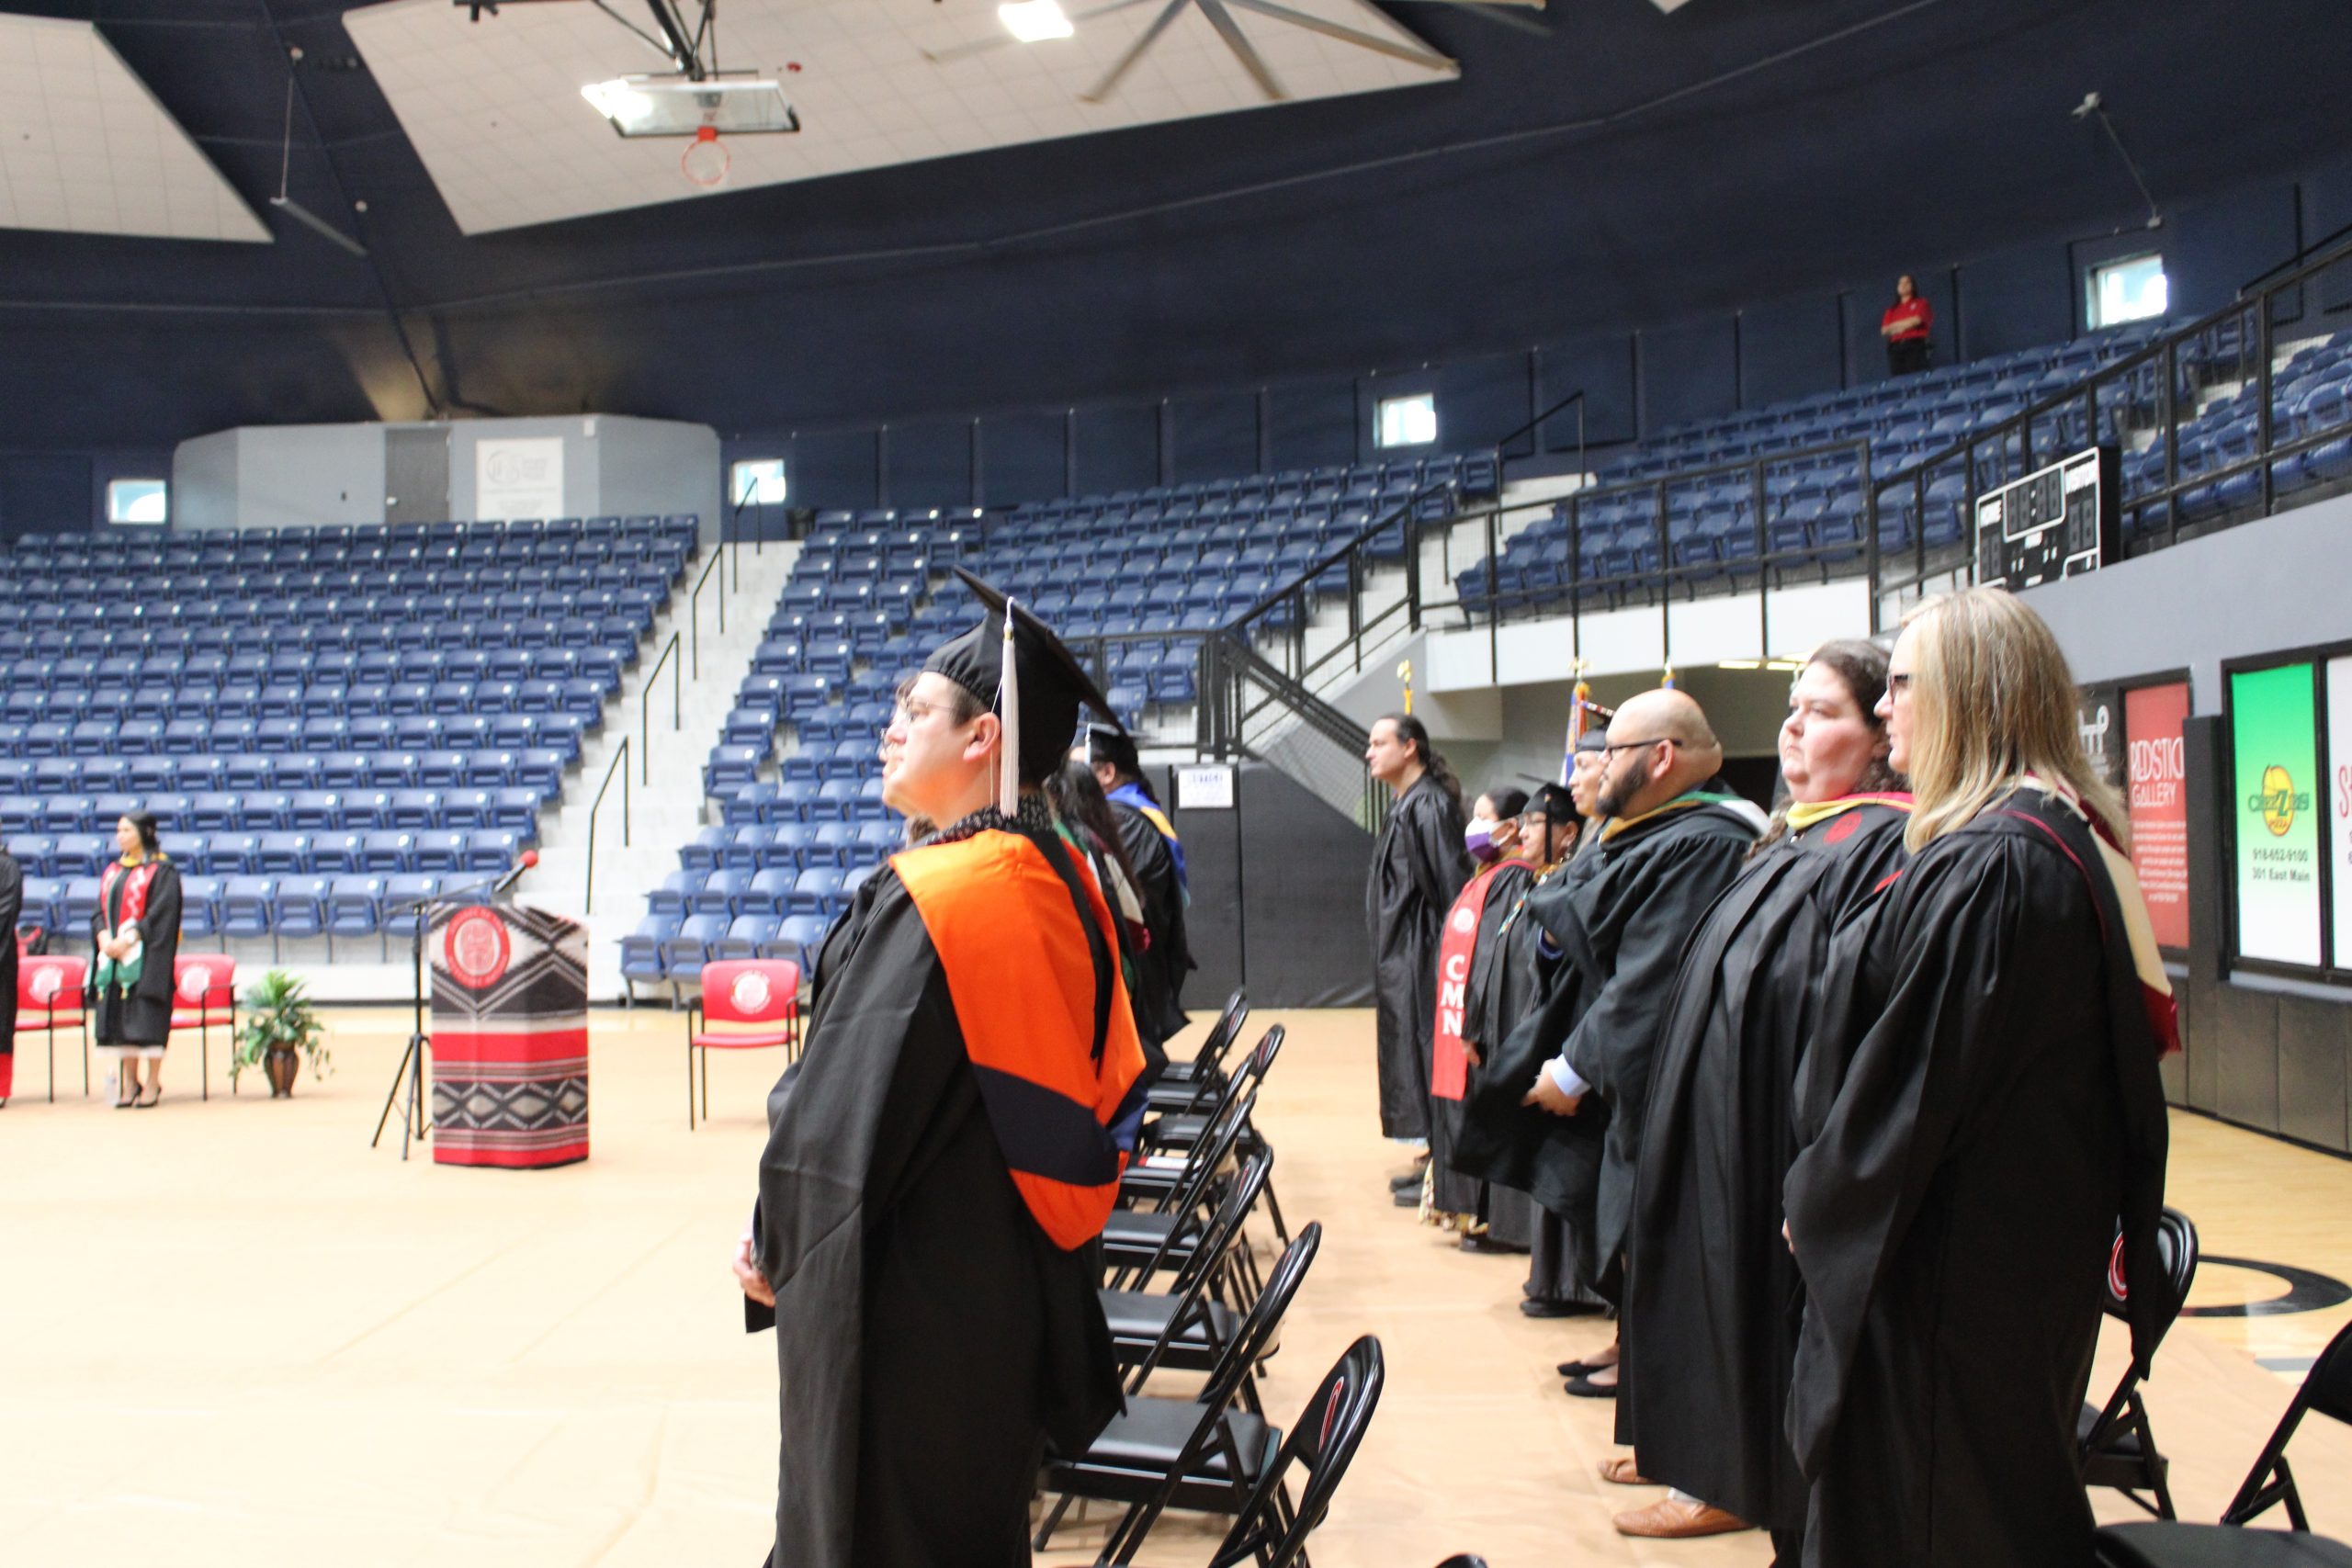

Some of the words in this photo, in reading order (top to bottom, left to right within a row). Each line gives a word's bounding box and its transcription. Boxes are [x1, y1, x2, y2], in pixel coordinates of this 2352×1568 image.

[2132, 782, 2176, 808] GALLERY
[2269, 867, 2287, 881] East
[2290, 868, 2311, 882] Main
